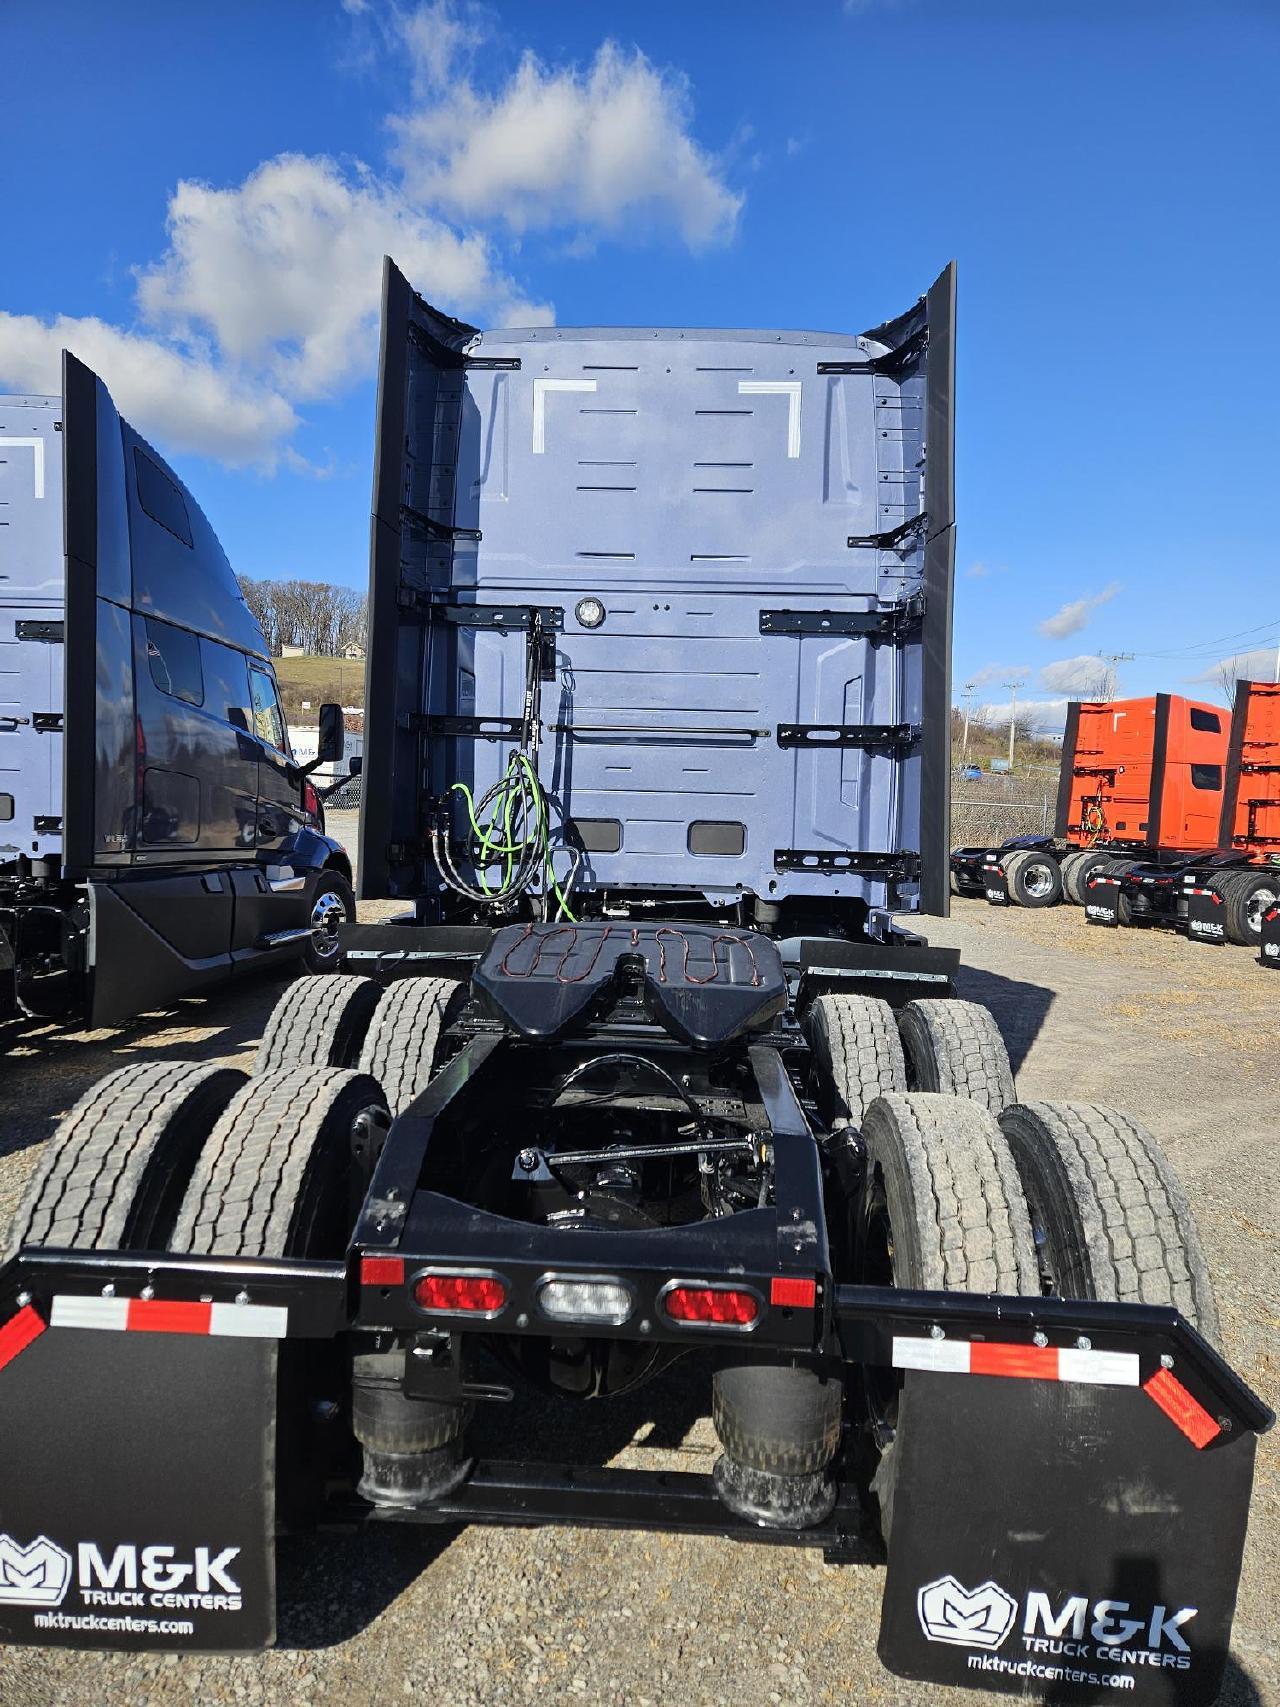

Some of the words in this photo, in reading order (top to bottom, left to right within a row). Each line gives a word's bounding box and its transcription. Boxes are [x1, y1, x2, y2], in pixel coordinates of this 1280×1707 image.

[77, 1542, 242, 1594] M&K
[80, 1590, 145, 1606] TRUCK
[150, 1592, 242, 1611] CENTERS
[34, 1611, 194, 1635] mktruckcenters.com
[1022, 1591, 1199, 1652] M&K
[1022, 1636, 1088, 1659] TRUCK
[1096, 1646, 1192, 1670] CENTERS
[967, 1653, 1136, 1691] mktruckcenters.com
